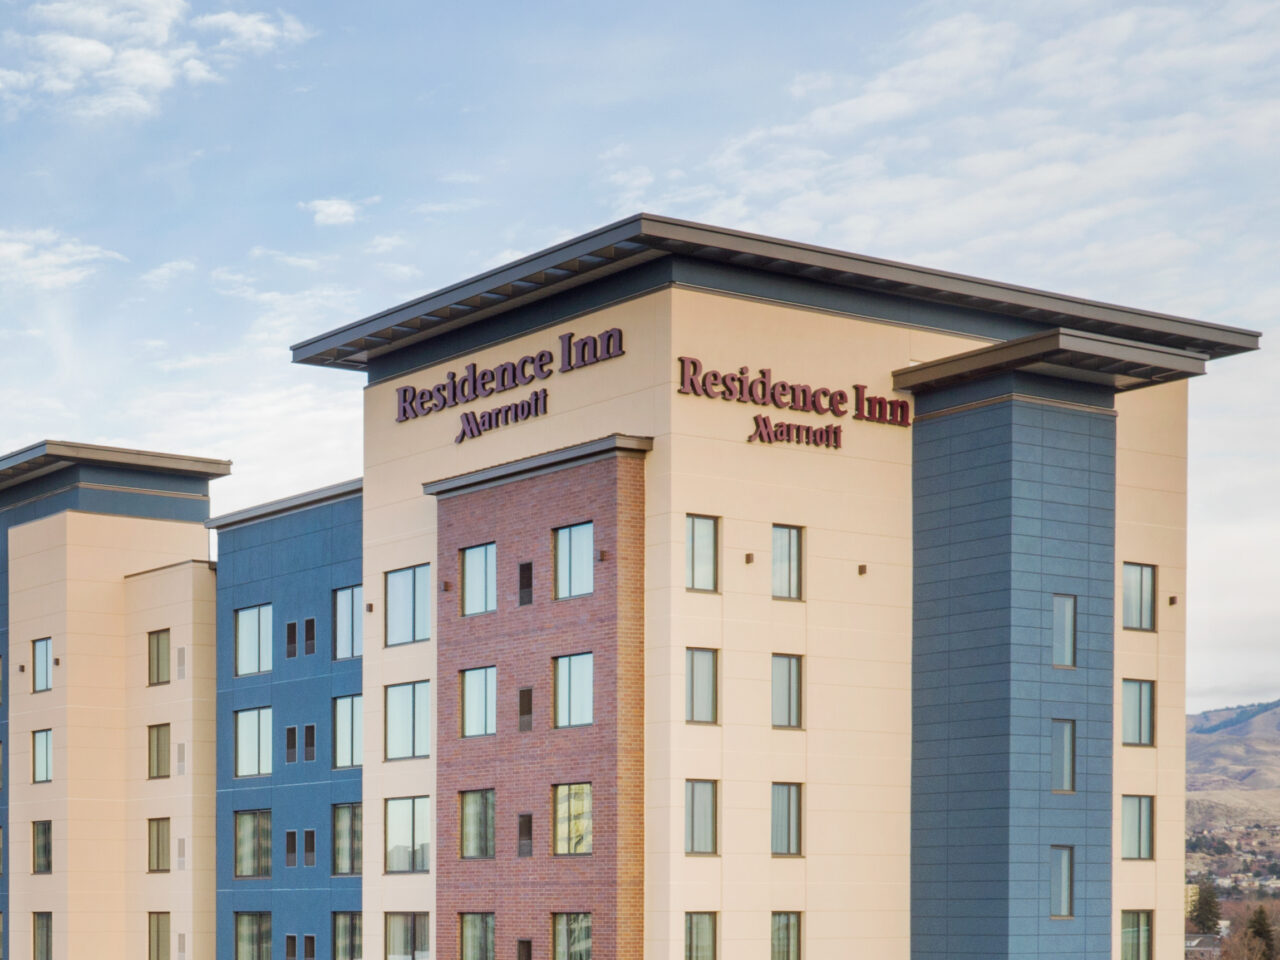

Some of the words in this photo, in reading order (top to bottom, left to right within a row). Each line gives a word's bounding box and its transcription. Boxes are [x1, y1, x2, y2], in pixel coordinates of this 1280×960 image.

[395, 362, 554, 424] Residence
[558, 326, 626, 374] Inn
[677, 355, 849, 418] Residence
[852, 383, 912, 428] Inn
[454, 387, 549, 445] Marriott
[747, 413, 843, 450] Marriott
